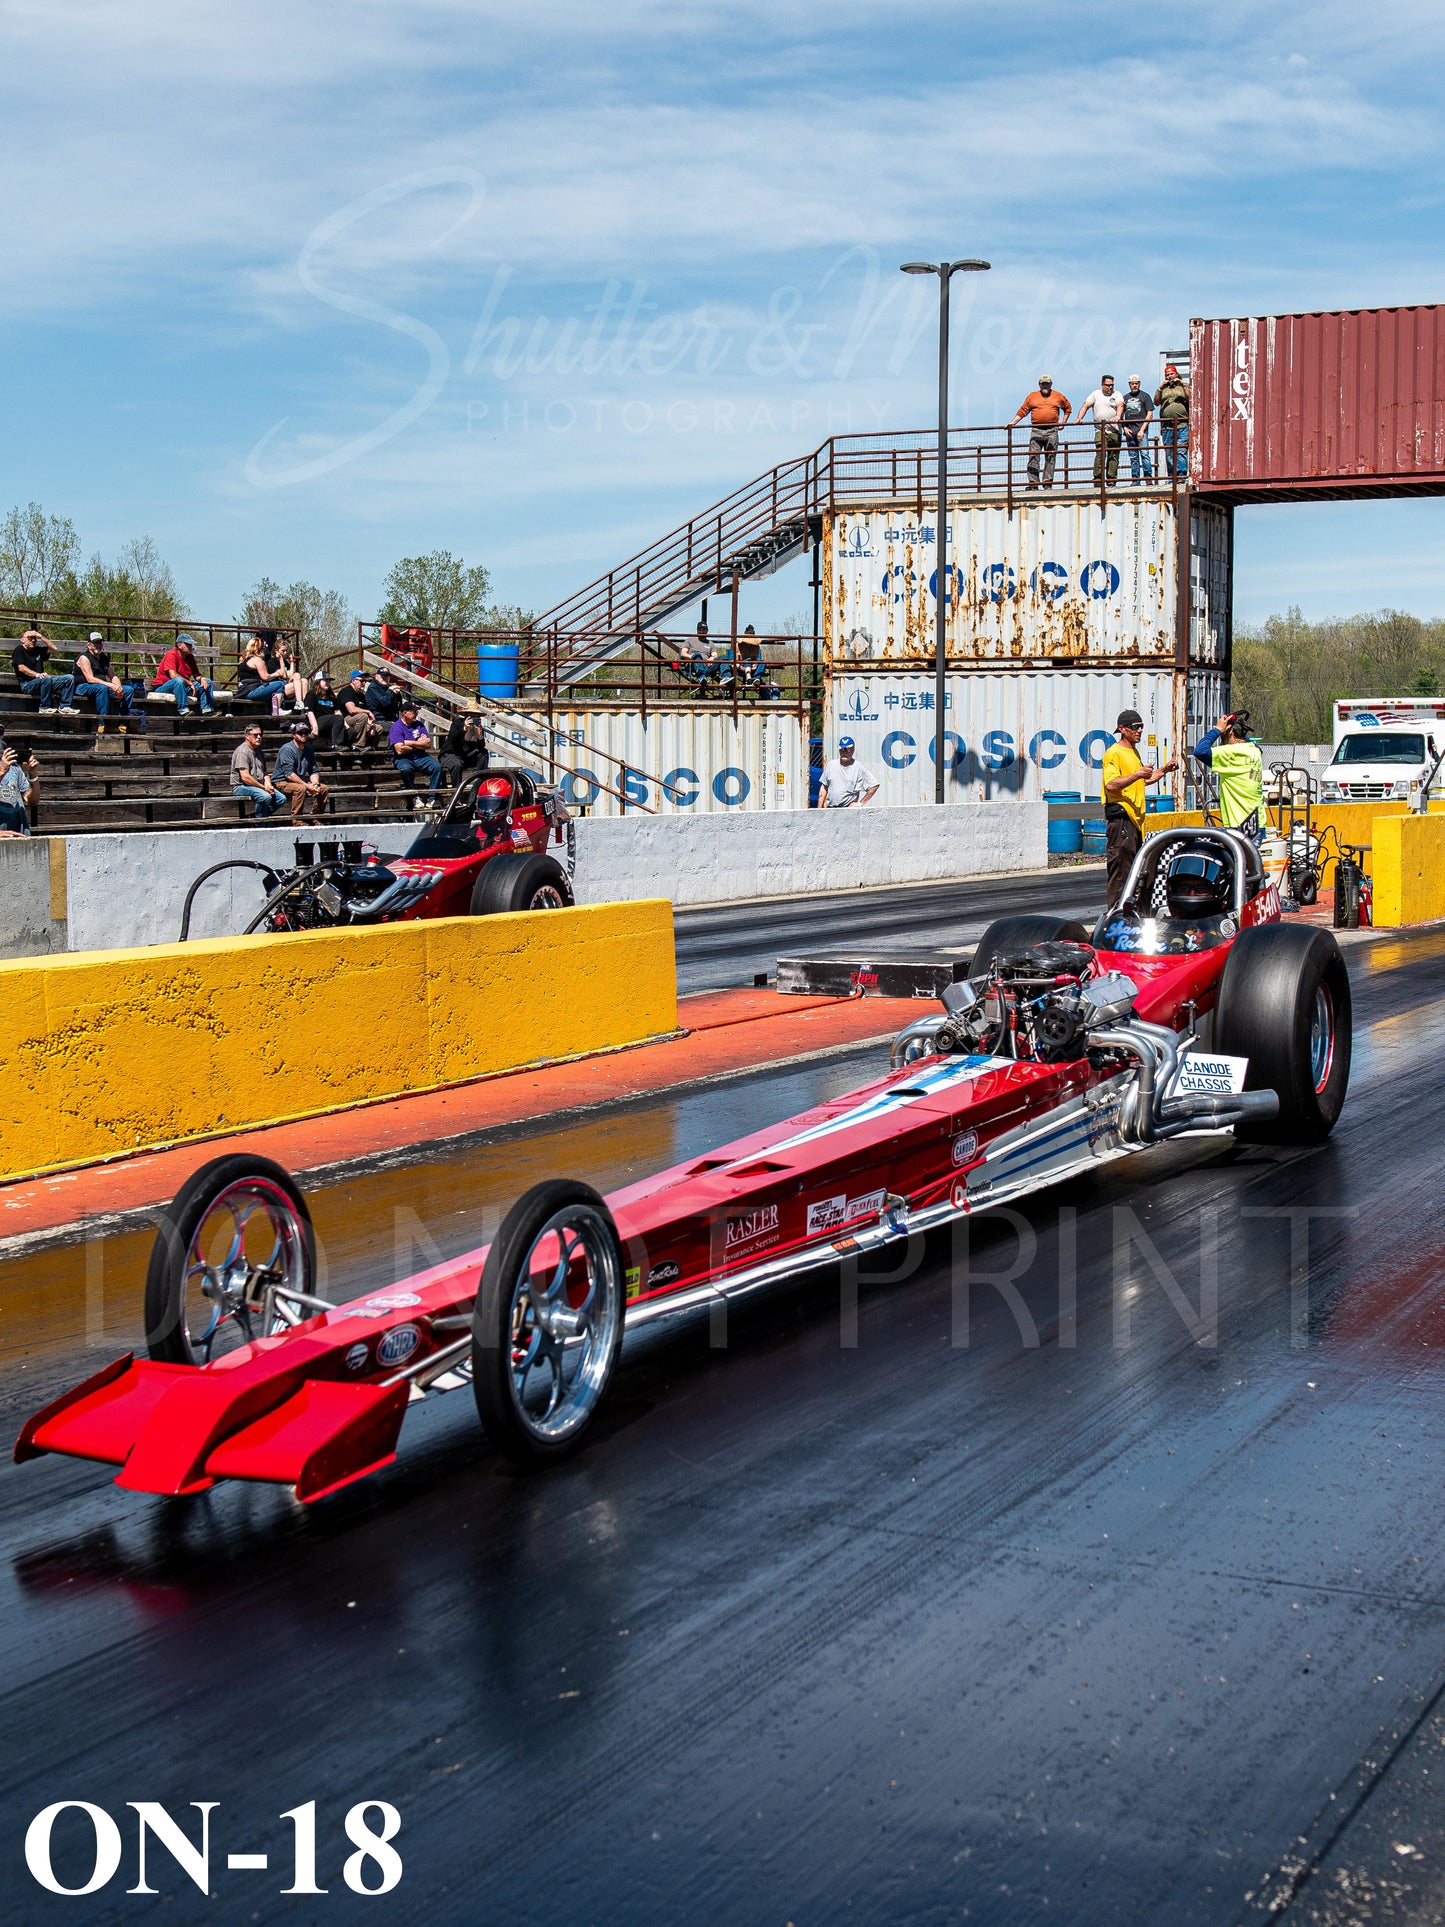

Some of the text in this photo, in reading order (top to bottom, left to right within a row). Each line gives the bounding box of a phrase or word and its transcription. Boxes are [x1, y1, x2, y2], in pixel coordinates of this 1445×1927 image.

[1231, 338, 1250, 420] tex
[882, 559, 1120, 604] COSCO
[881, 730, 1118, 770] COSCO
[521, 767, 751, 807] OSCO
[1180, 1076, 1232, 1091] CHASSIS
[1183, 1060, 1233, 1076] CANODE
[725, 1204, 779, 1244] RASLER
[722, 1233, 780, 1264] Insurance Services
